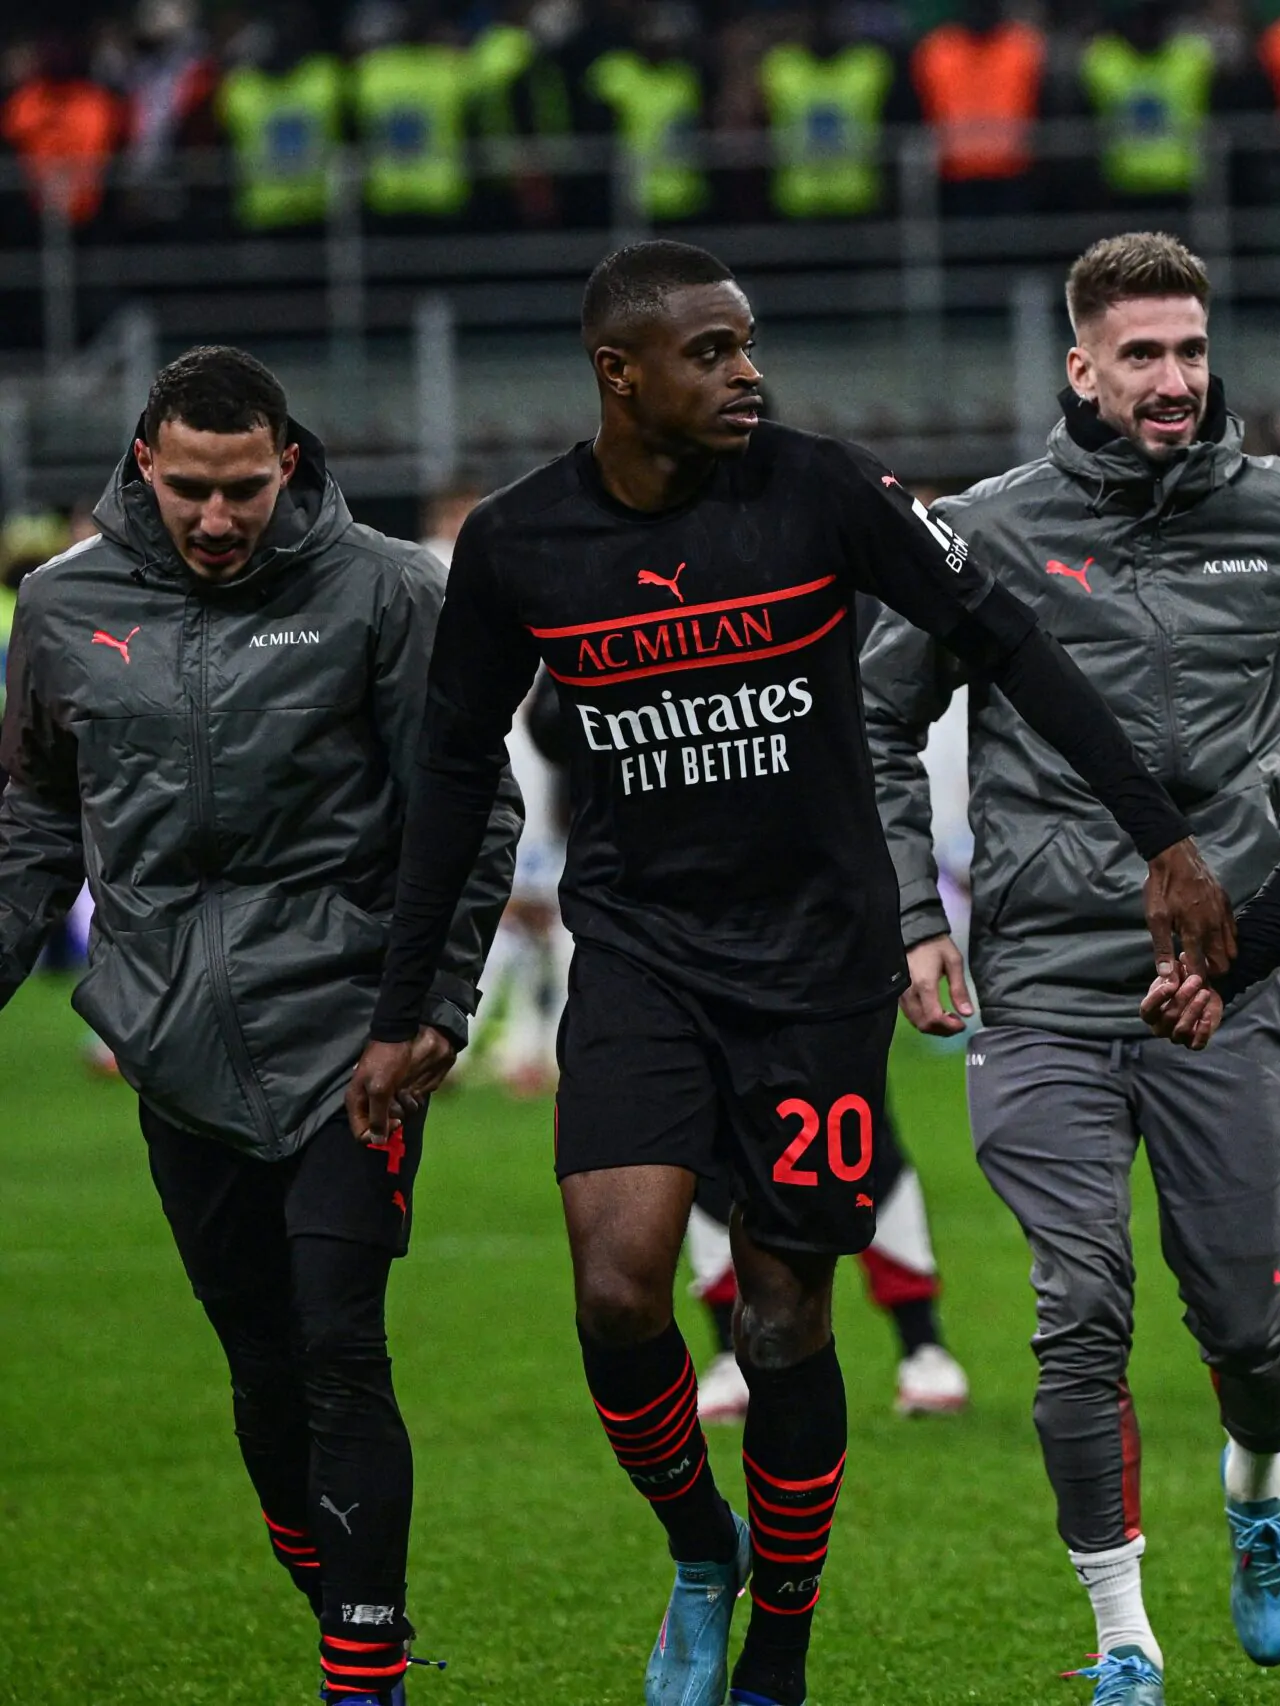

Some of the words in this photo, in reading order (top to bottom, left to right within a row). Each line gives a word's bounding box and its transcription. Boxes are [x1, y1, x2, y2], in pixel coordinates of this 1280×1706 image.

[632, 608, 773, 663] MILAN
[575, 676, 813, 751] Emirates
[621, 749, 667, 796] FLY
[681, 733, 790, 785] BETTER
[773, 1093, 873, 1186] 20
